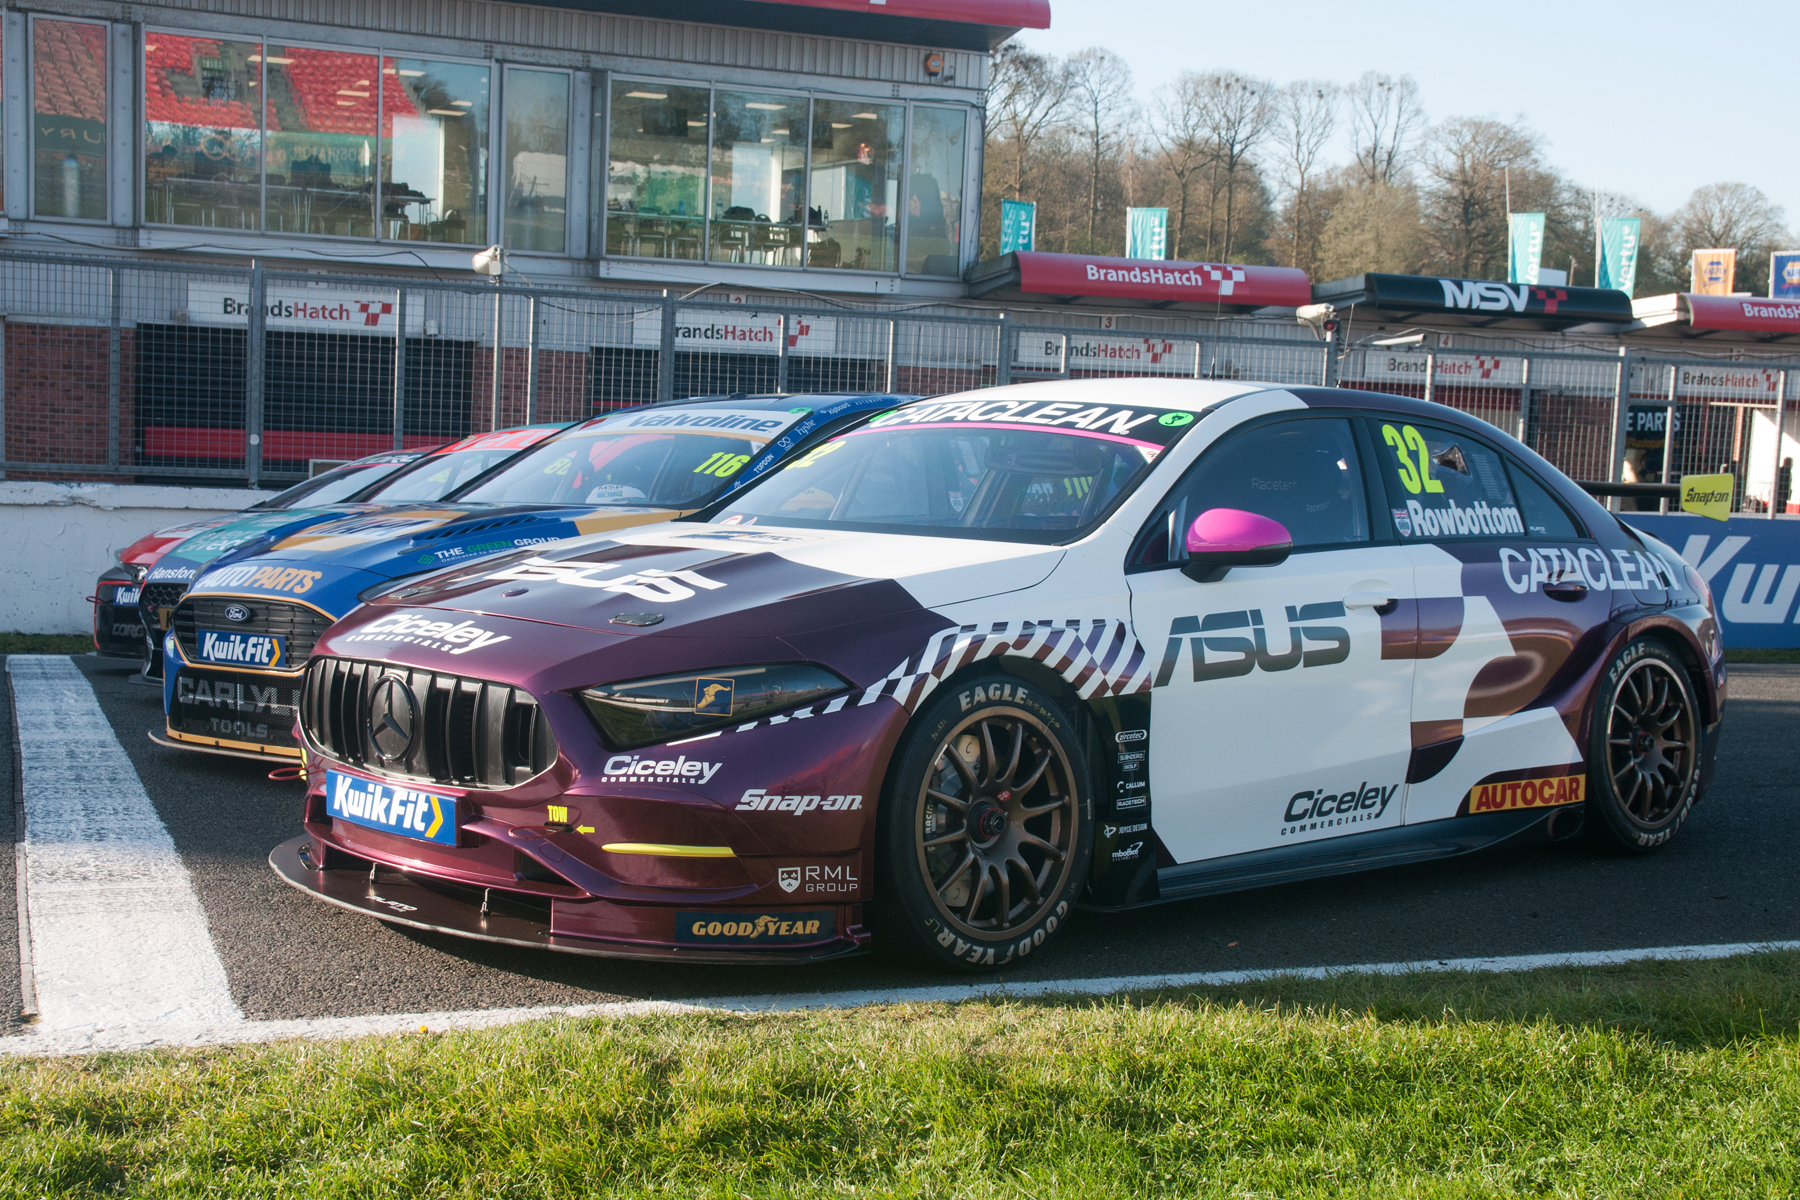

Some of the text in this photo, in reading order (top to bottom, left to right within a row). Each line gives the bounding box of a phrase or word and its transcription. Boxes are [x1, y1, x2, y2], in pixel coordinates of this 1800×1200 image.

[1085, 264, 1203, 287] BrandsHatch
[1438, 279, 1530, 312] MSV
[223, 297, 351, 321] BrdsHatch
[675, 323, 773, 342] randsHatch
[1104, 316, 1113, 329] 3
[1044, 340, 1141, 360] BrndsHatch
[1441, 335, 1450, 347] 4
[1387, 356, 1472, 375] BrandHatch
[627, 412, 784, 432] Valvoline
[869, 400, 1158, 435] CATACLEAN
[693, 451, 751, 478] 116
[753, 453, 775, 474] TOPDON
[1381, 423, 1445, 495] 32
[1684, 486, 1730, 506] Snap-on
[1406, 498, 1526, 538] Rowbottom
[434, 546, 465, 559] THE
[466, 540, 513, 553] GREEN
[1499, 547, 1682, 595] CATACLEAN
[226, 606, 248, 620] Ford
[345, 634, 453, 652] COMMERCIALS
[360, 613, 513, 655] Ciceley
[1152, 600, 1351, 689] ASUS
[1608, 641, 1646, 686] EAGLE
[958, 682, 1029, 713] EAGLE
[209, 716, 269, 739] TOOLS
[601, 776, 696, 785] COMMERCIALS
[603, 754, 724, 785] Ciceley
[1125, 780, 1146, 790] CALLUM
[1475, 776, 1581, 812] AUTOCAR
[734, 788, 863, 816] Snap-on
[1283, 780, 1400, 823] Ciceley
[547, 804, 569, 824] TOW
[1280, 812, 1373, 837] COMMERCIALS
[805, 865, 858, 881] RML
[805, 882, 858, 893] GROUP
